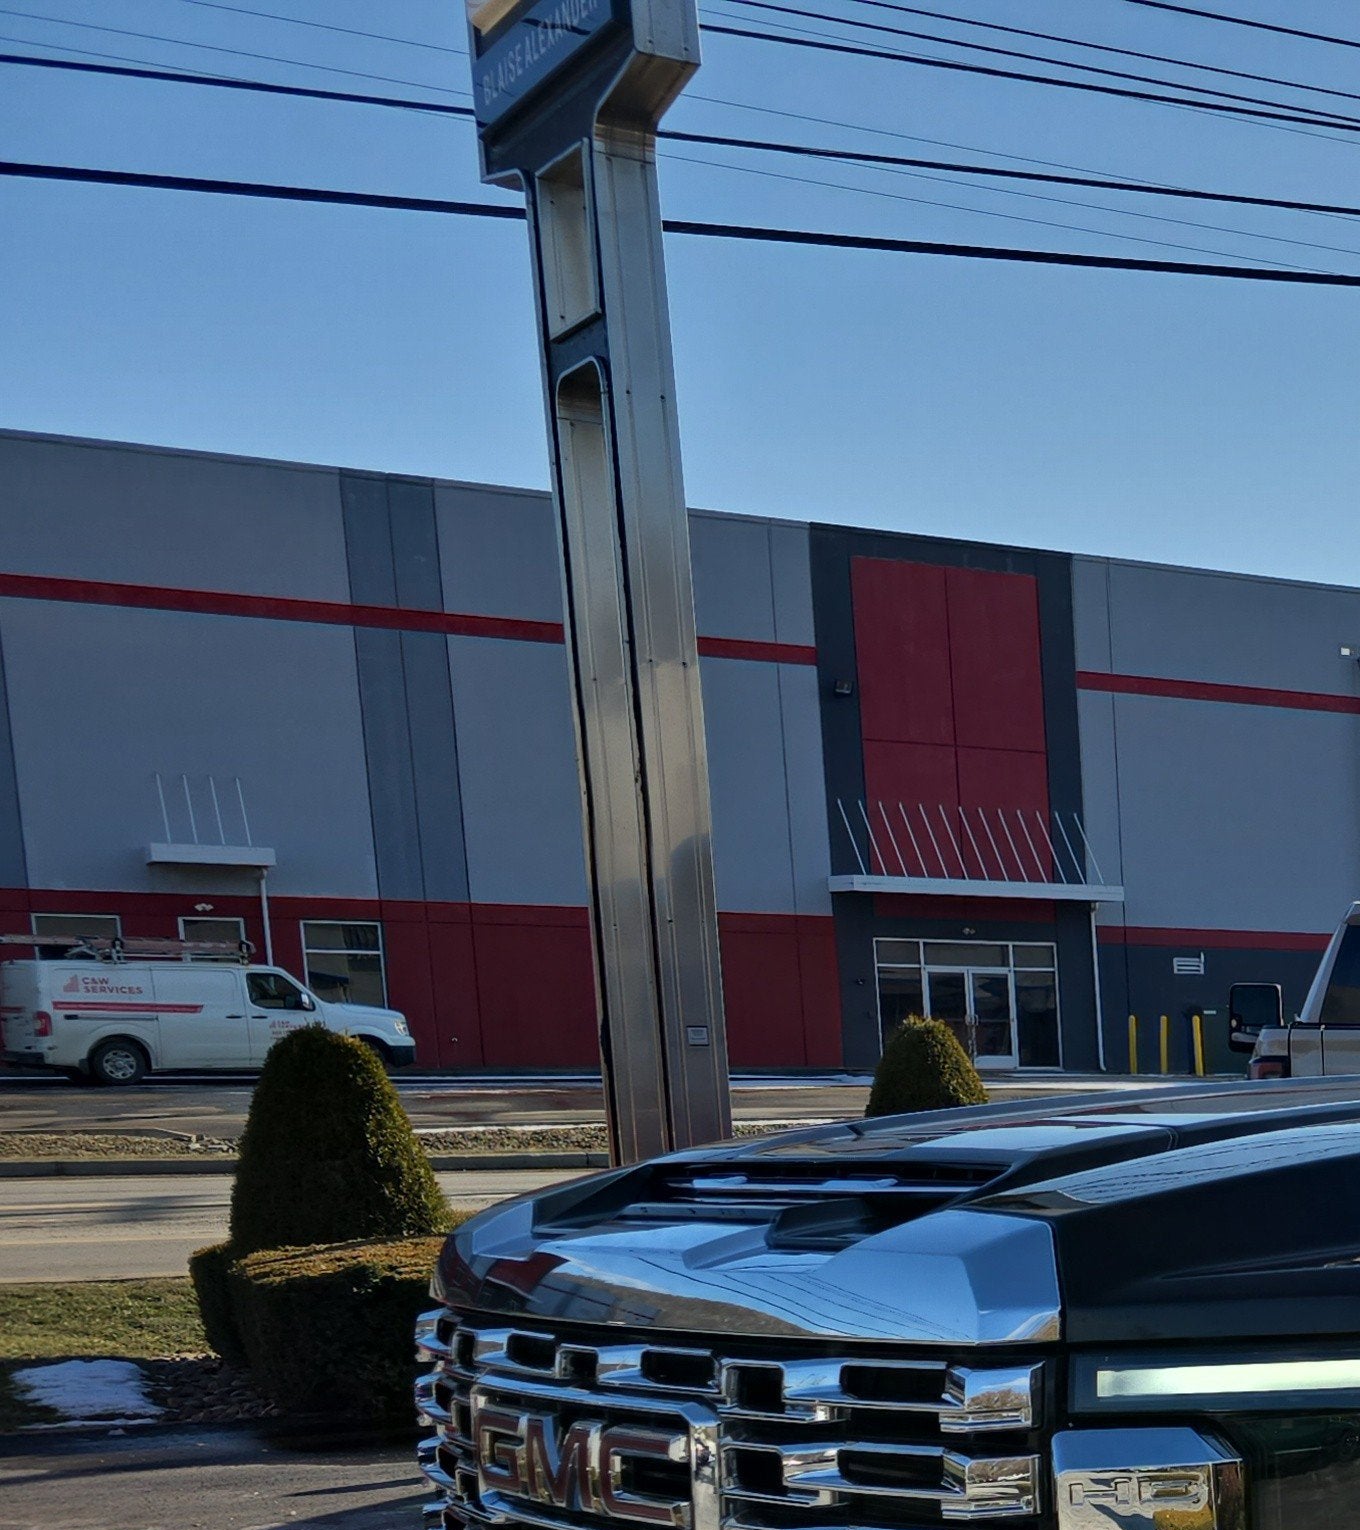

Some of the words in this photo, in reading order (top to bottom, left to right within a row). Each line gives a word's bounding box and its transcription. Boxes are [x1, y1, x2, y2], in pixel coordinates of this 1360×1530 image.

[482, 43, 523, 105] BLAISE
[83, 985, 143, 995] SERVICES
[474, 1403, 691, 1530] GMC
[1068, 1473, 1203, 1506] HD
